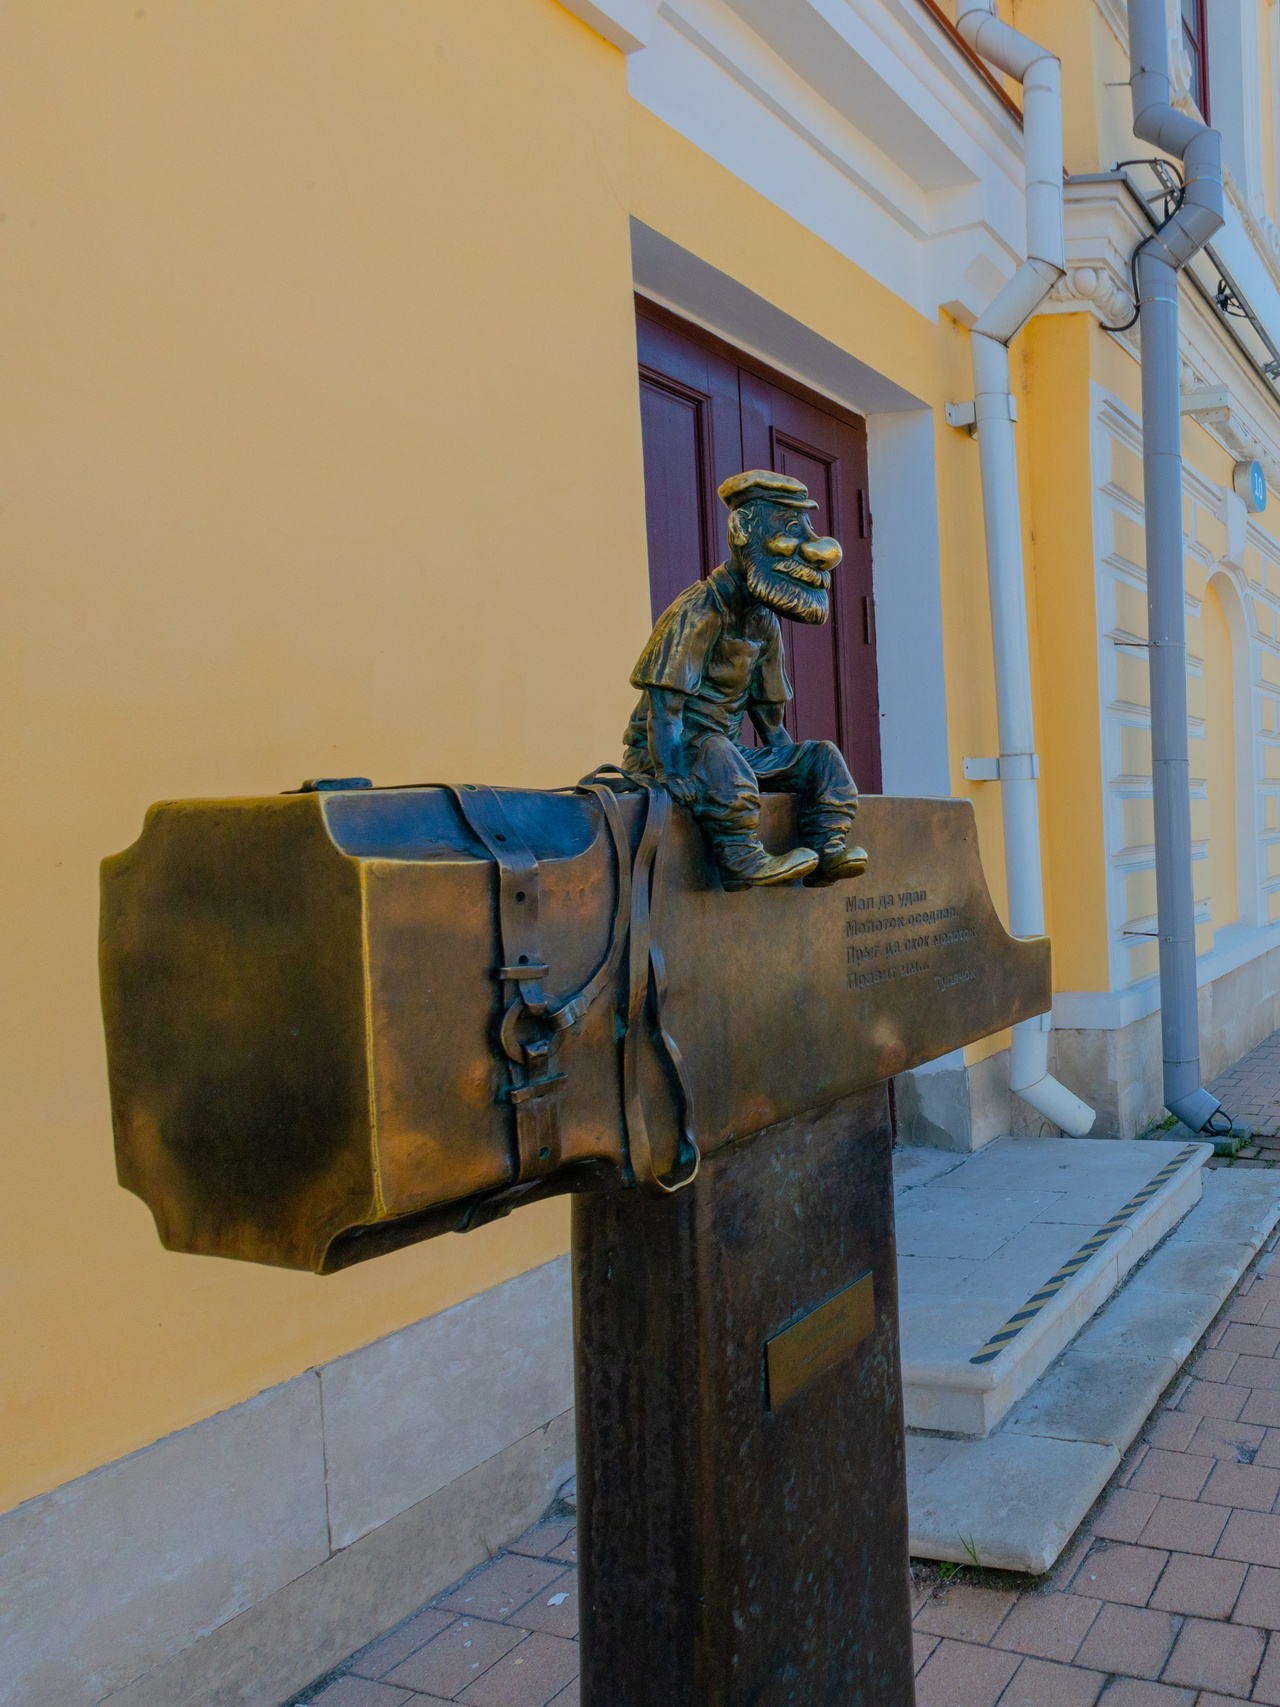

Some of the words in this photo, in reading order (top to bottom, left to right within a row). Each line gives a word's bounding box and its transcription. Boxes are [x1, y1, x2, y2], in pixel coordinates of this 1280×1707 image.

[1254, 473, 1263, 500] 10
[846, 896, 874, 913] Мал
[878, 894, 894, 910] да
[898, 890, 927, 908] удал
[846, 916, 905, 937] Молоток
[847, 945, 880, 967] Прыг
[885, 941, 900, 959] да
[905, 935, 930, 953] скок
[847, 966, 898, 991] Правит
